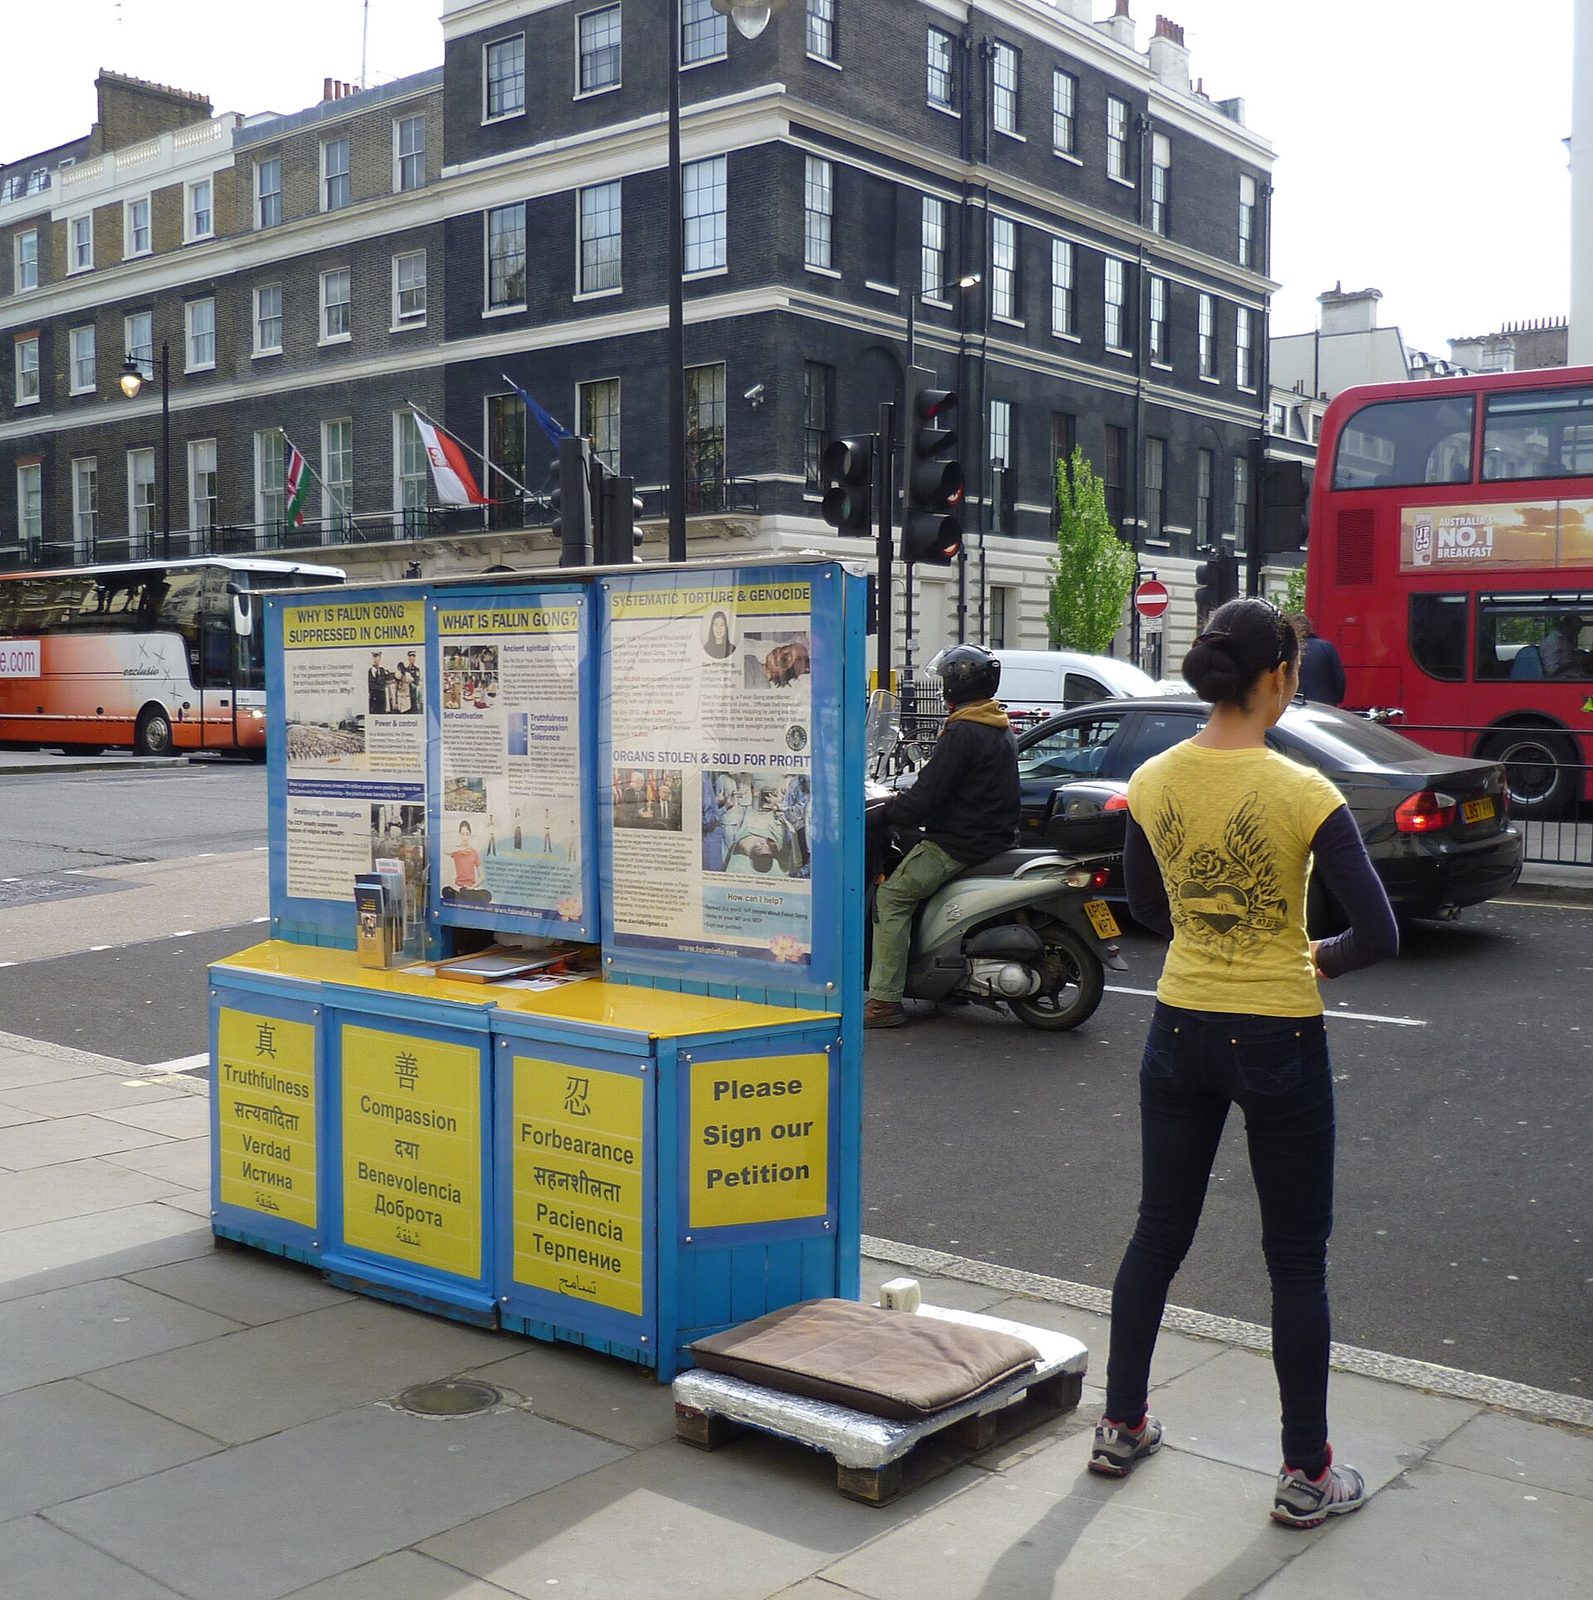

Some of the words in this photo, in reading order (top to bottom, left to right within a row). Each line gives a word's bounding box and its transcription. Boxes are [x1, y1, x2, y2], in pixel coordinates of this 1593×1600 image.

[1438, 526, 1493, 548] NO.1
[1437, 547, 1492, 559] BREAKFAST
[612, 593, 678, 607] SYSTEMATIC
[682, 590, 734, 604] TORTURE
[737, 590, 747, 602] &
[750, 587, 810, 602] GENOCIDE
[297, 609, 321, 624] WHY
[324, 608, 334, 622] IS
[337, 606, 370, 621] FALUN
[373, 605, 405, 620] GONG
[443, 615, 475, 629] WHAT
[478, 614, 489, 628] IS
[492, 612, 529, 628] FALUN
[532, 611, 577, 627] GONG?
[289, 626, 357, 643] SUPPRESSED
[360, 625, 370, 640] IN
[374, 624, 415, 640] CHINA?
[526, 644, 550, 653] spiritual
[551, 645, 576, 653] practice
[340, 687, 355, 696] Why?
[374, 719, 392, 728] Power
[392, 719, 398, 727] &
[398, 719, 418, 727] control
[443, 711, 484, 720] Self-cultivation
[530, 713, 569, 722] Truthfulness
[530, 724, 569, 733] Compassion
[530, 733, 561, 742] Tolerance
[612, 750, 656, 762] ORGANS
[659, 752, 698, 764] STOLEN
[701, 753, 710, 764] &
[712, 753, 741, 765] SOLD
[744, 754, 766, 766] FOR
[769, 755, 811, 768] PROFIT
[293, 807, 320, 817] Destroying
[321, 809, 335, 817] other
[727, 893, 743, 901] How
[745, 895, 758, 903] can
[763, 896, 784, 905] help?
[256, 1022, 277, 1060] 真
[223, 1063, 310, 1099] Truthfulness
[394, 1051, 420, 1092] 善
[564, 1075, 591, 1117] 忍
[713, 1077, 803, 1102] Please
[234, 1101, 300, 1131] सत्यवादिता
[360, 1095, 457, 1133] Compassion
[521, 1123, 635, 1166] Forbearance
[703, 1123, 761, 1149] Sign
[771, 1120, 814, 1139] our
[242, 1134, 291, 1163] Verdad
[394, 1139, 420, 1161] दया
[242, 1162, 293, 1190] Истина
[358, 1161, 462, 1204] Benevolencia
[533, 1165, 622, 1203] सहनशीलता
[706, 1161, 810, 1190] Petition
[375, 1194, 443, 1229] Доброта
[536, 1202, 624, 1243] Paciencia
[532, 1232, 622, 1273] Терпение
